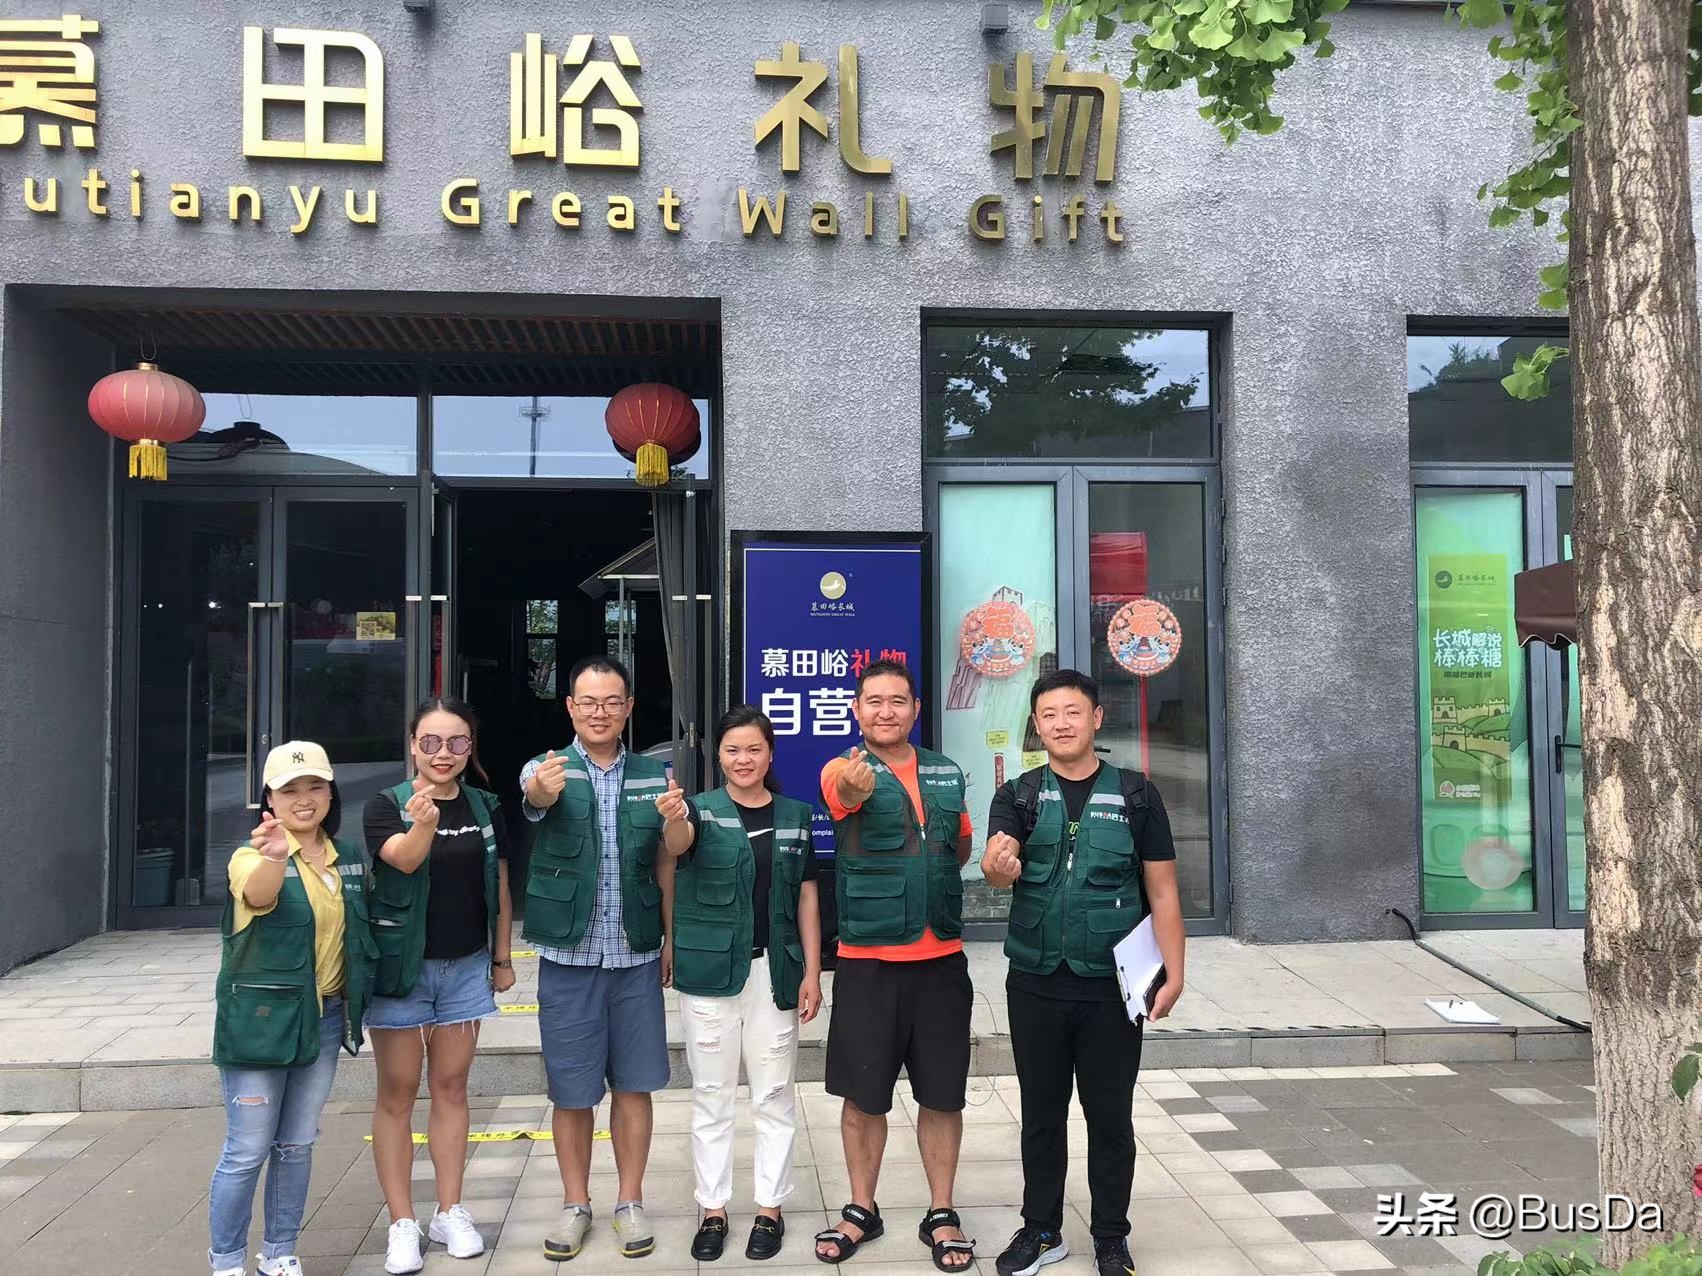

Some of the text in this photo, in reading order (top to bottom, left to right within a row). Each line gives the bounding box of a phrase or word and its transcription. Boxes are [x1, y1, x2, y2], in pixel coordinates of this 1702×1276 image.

[441, 178, 682, 233] Great
[738, 188, 909, 239] Wall
[968, 194, 1125, 245] Gift
[1432, 628, 1502, 648] 长城解说
[1433, 647, 1502, 668] 棒棒糖
[761, 688, 863, 736] 自营
[812, 829, 834, 837] omplai
